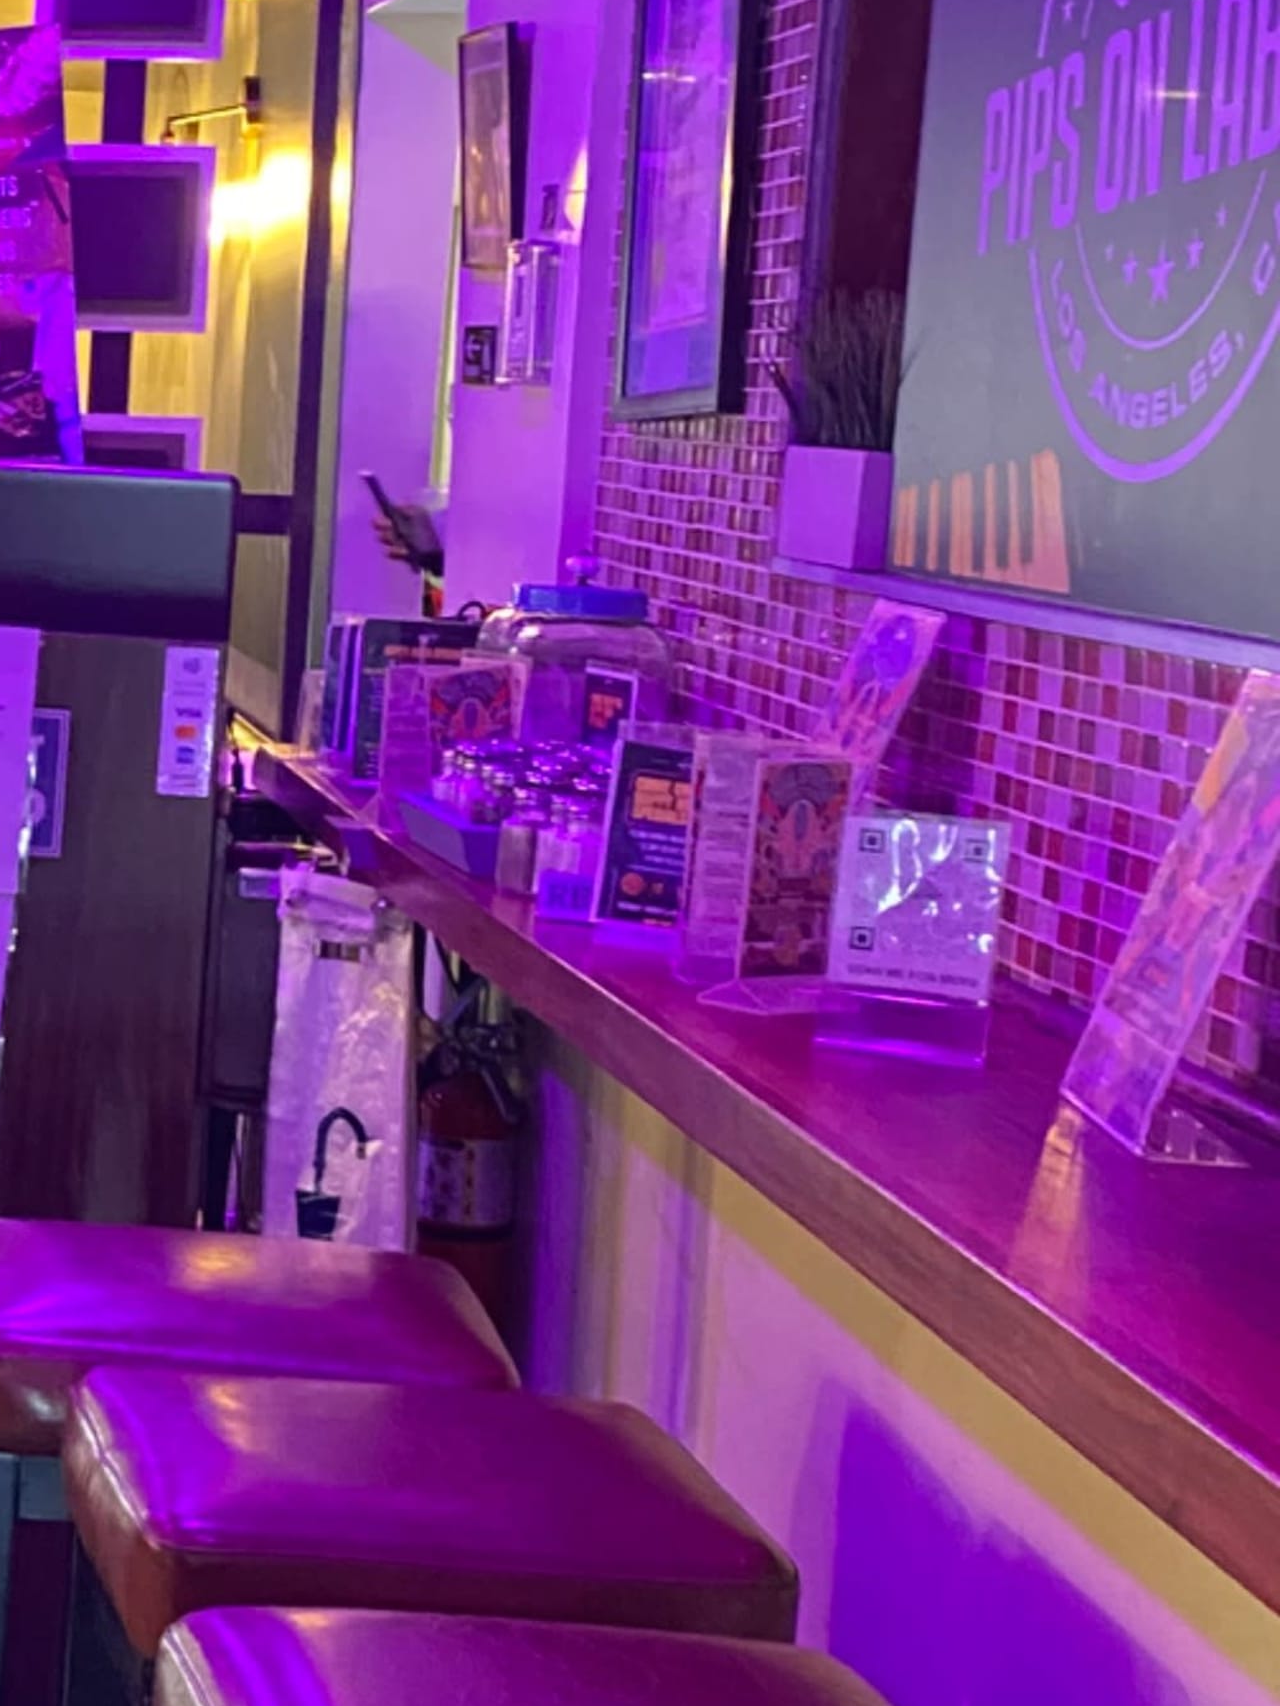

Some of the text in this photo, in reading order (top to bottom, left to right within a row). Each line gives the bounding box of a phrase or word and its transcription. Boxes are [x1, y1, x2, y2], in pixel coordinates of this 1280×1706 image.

[977, 51, 1085, 257] PIPS
[1095, 9, 1172, 214] ON
[1050, 258, 1087, 374] LOS
